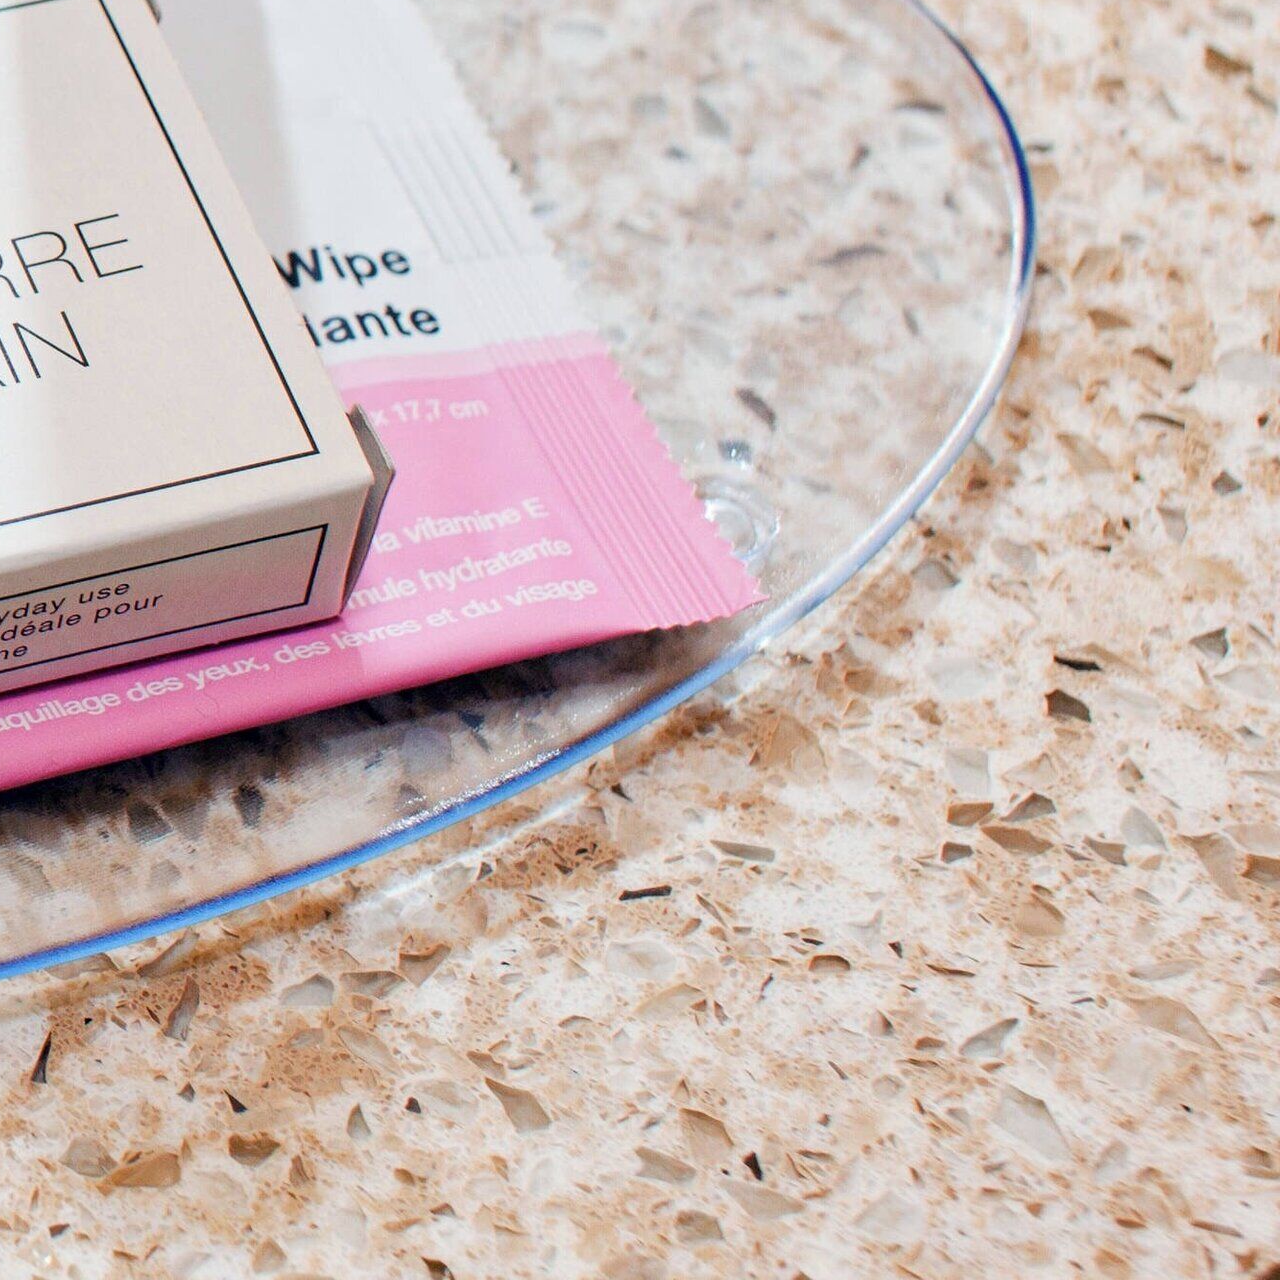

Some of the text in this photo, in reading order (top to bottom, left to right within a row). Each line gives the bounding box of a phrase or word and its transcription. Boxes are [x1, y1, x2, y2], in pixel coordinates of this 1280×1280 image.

[272, 246, 412, 289] Wipe
[374, 496, 550, 554] la vitamine E
[417, 536, 573, 592] hydratante
[79, 581, 131, 604] use
[94, 594, 164, 623] pour
[126, 673, 184, 704] des
[186, 654, 270, 692] yeux,
[274, 639, 331, 667] des
[332, 618, 422, 650] lèvres
[427, 608, 459, 628] et
[461, 596, 503, 619] du
[505, 577, 599, 609] visage
